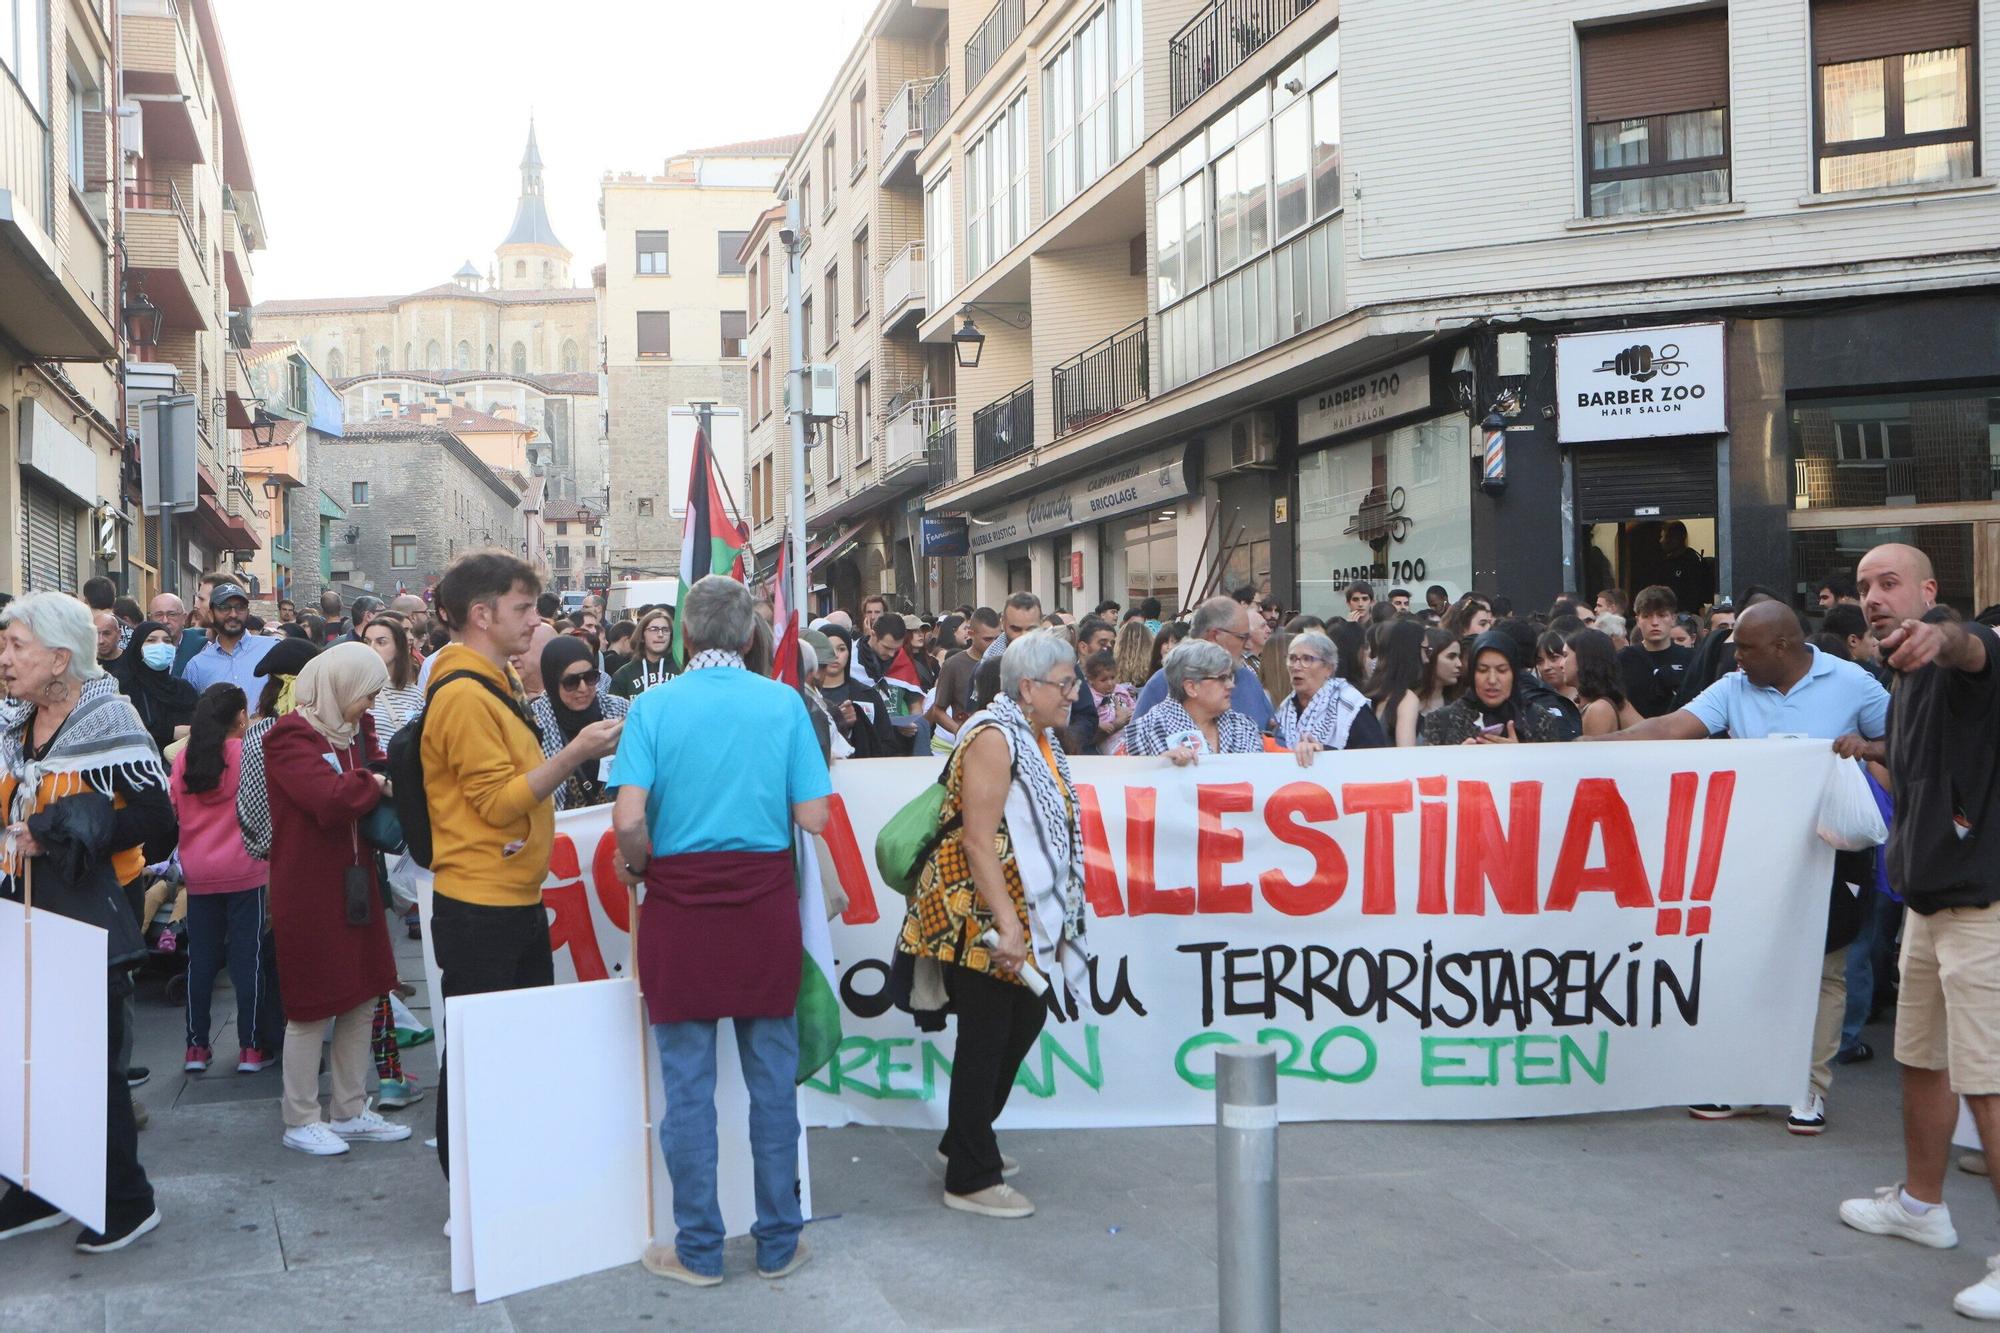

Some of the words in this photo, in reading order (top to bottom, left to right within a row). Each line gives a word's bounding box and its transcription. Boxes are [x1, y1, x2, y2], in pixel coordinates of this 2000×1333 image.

[1578, 388, 1654, 407] BARBER
[1661, 384, 1705, 401] ZOO
[1333, 417, 1353, 430] HAIR
[1357, 405, 1385, 423] SALON
[1601, 407, 1632, 416] HAIR
[1640, 403, 1682, 414] SALON
[1087, 464, 1140, 492] CARPINTERIA
[1090, 487, 1138, 512] BRICOLAGE
[1392, 557, 1426, 585] ZOO
[1420, 1031, 1608, 1086] ETEN
